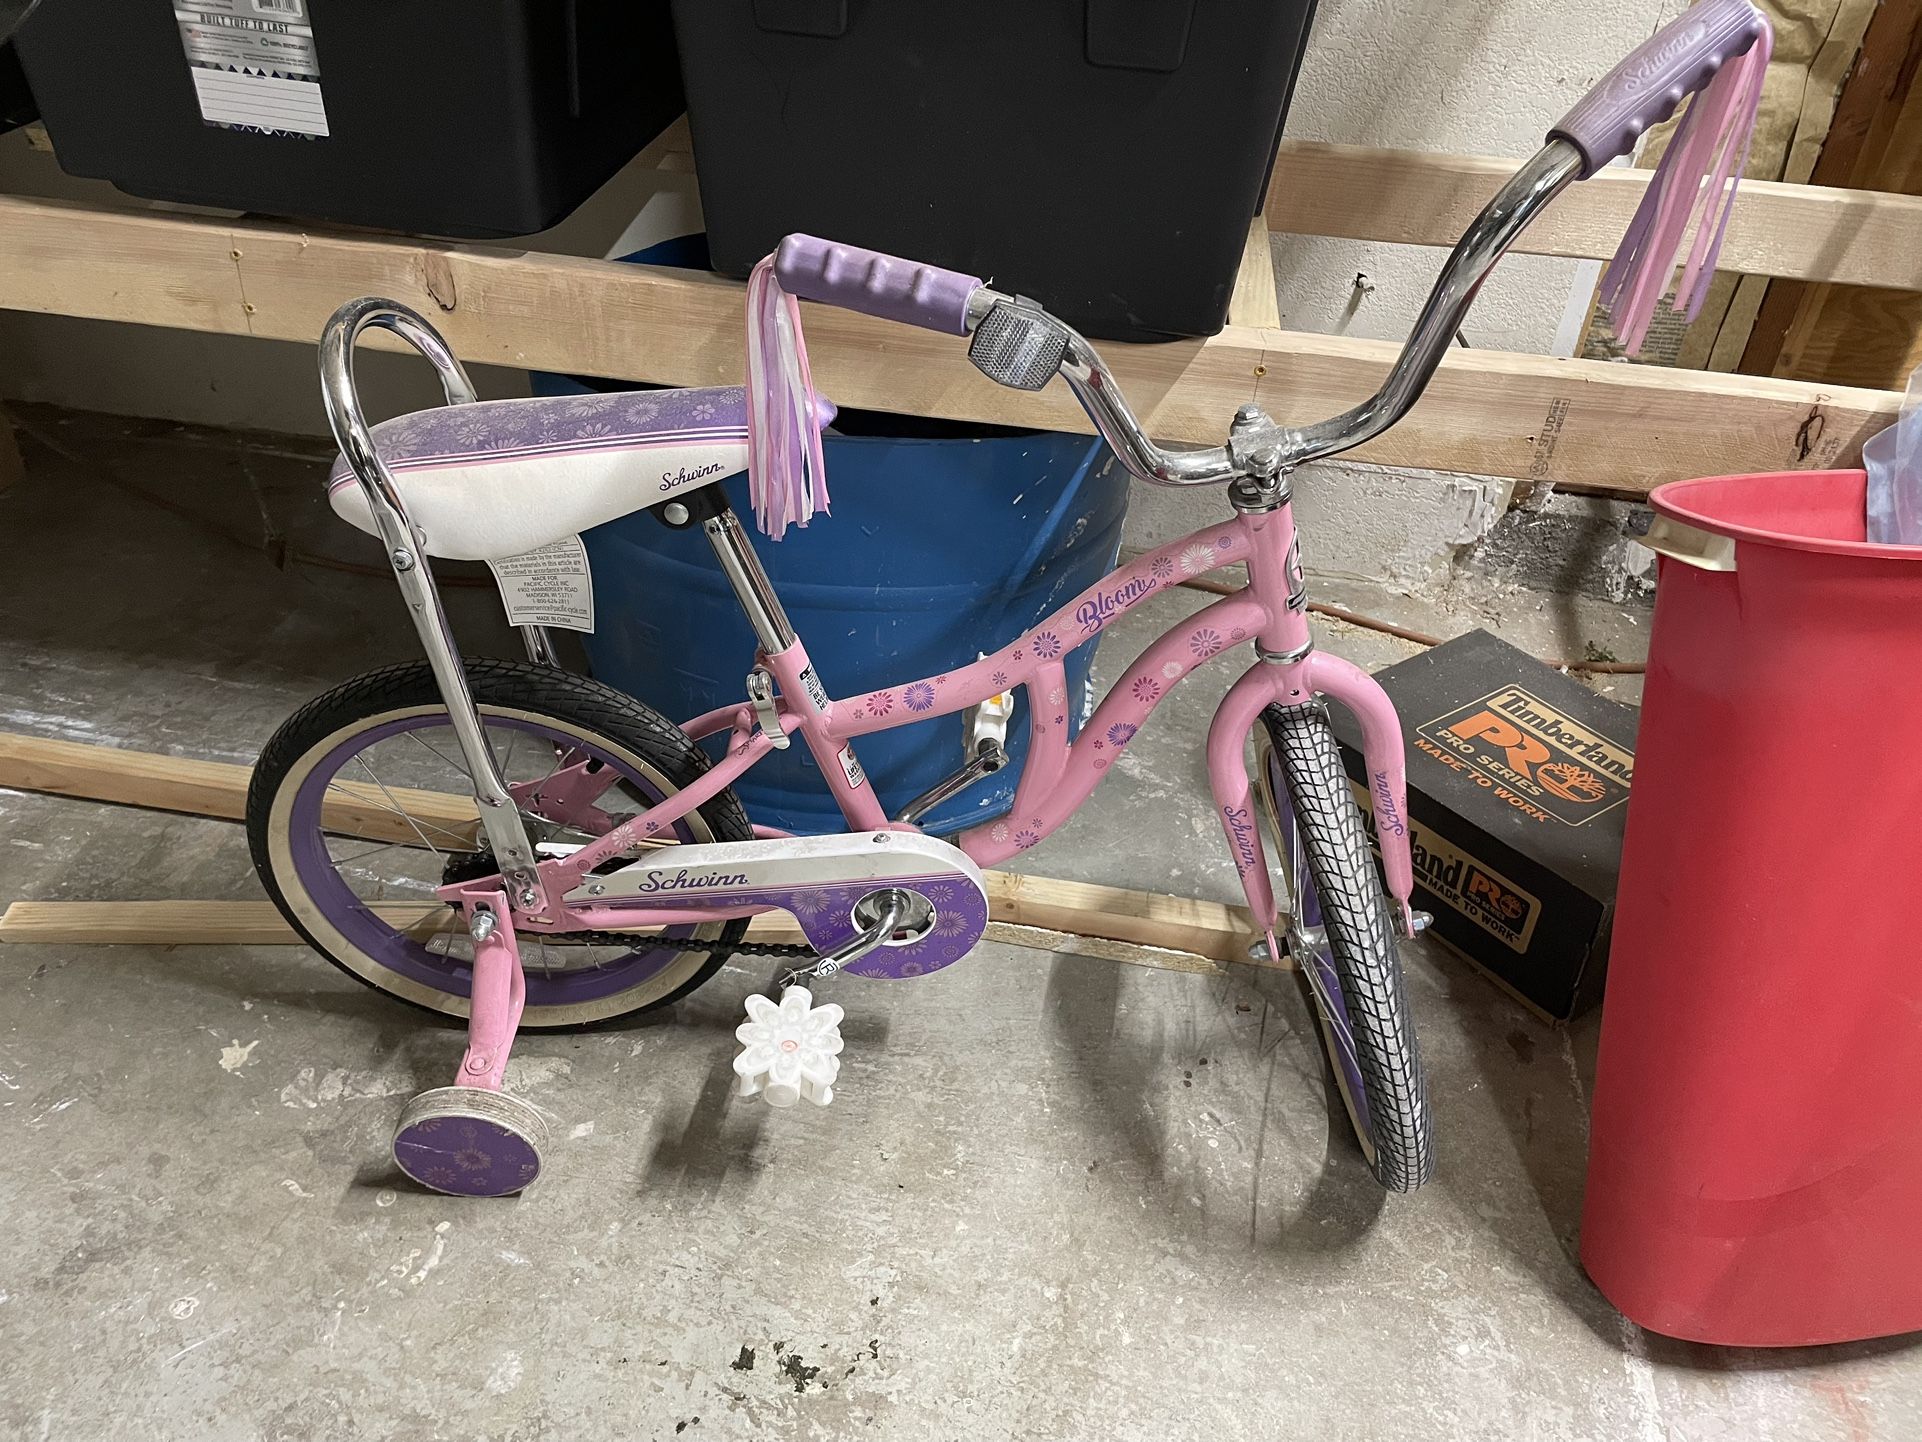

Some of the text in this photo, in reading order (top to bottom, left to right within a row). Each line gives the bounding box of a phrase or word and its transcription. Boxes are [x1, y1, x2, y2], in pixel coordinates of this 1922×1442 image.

[200, 13, 289, 34] BUILT TUFF TO LAST
[1538, 415, 1557, 447] STUD
[659, 463, 721, 491] Schwinn
[1076, 576, 1156, 634] Bloom
[1413, 738, 1551, 823] MADE TO WORK
[1435, 728, 1545, 797] PRO SERIES
[1374, 772, 1405, 836] Schwinn
[1223, 805, 1256, 867] Schwinn
[639, 869, 748, 893] Schwinn
[1427, 876, 1516, 944] MADE TO WORK
